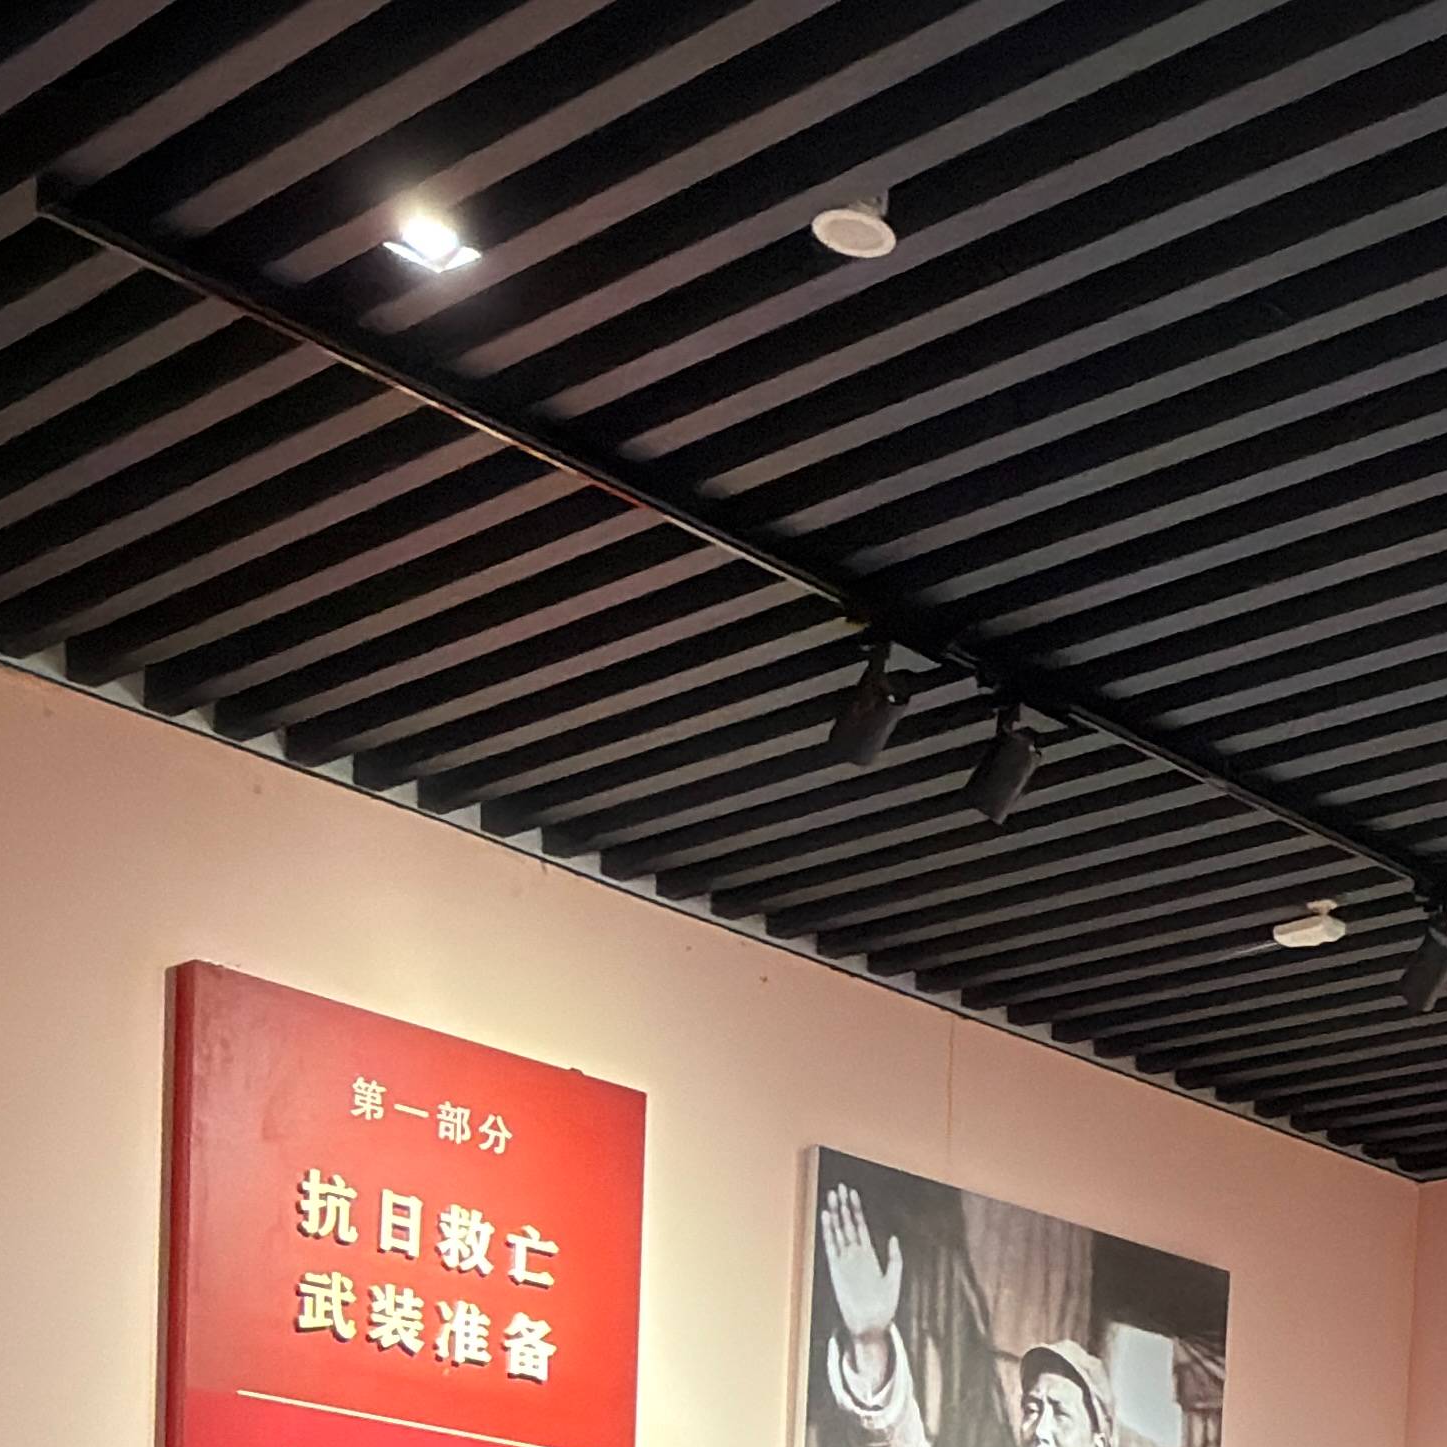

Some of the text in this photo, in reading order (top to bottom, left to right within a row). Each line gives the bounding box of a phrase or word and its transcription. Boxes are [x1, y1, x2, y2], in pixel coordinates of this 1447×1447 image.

[350, 1076, 514, 1155] 第一部分
[297, 1168, 560, 1288] 抗日救亡
[296, 1271, 558, 1384] 武装准备
